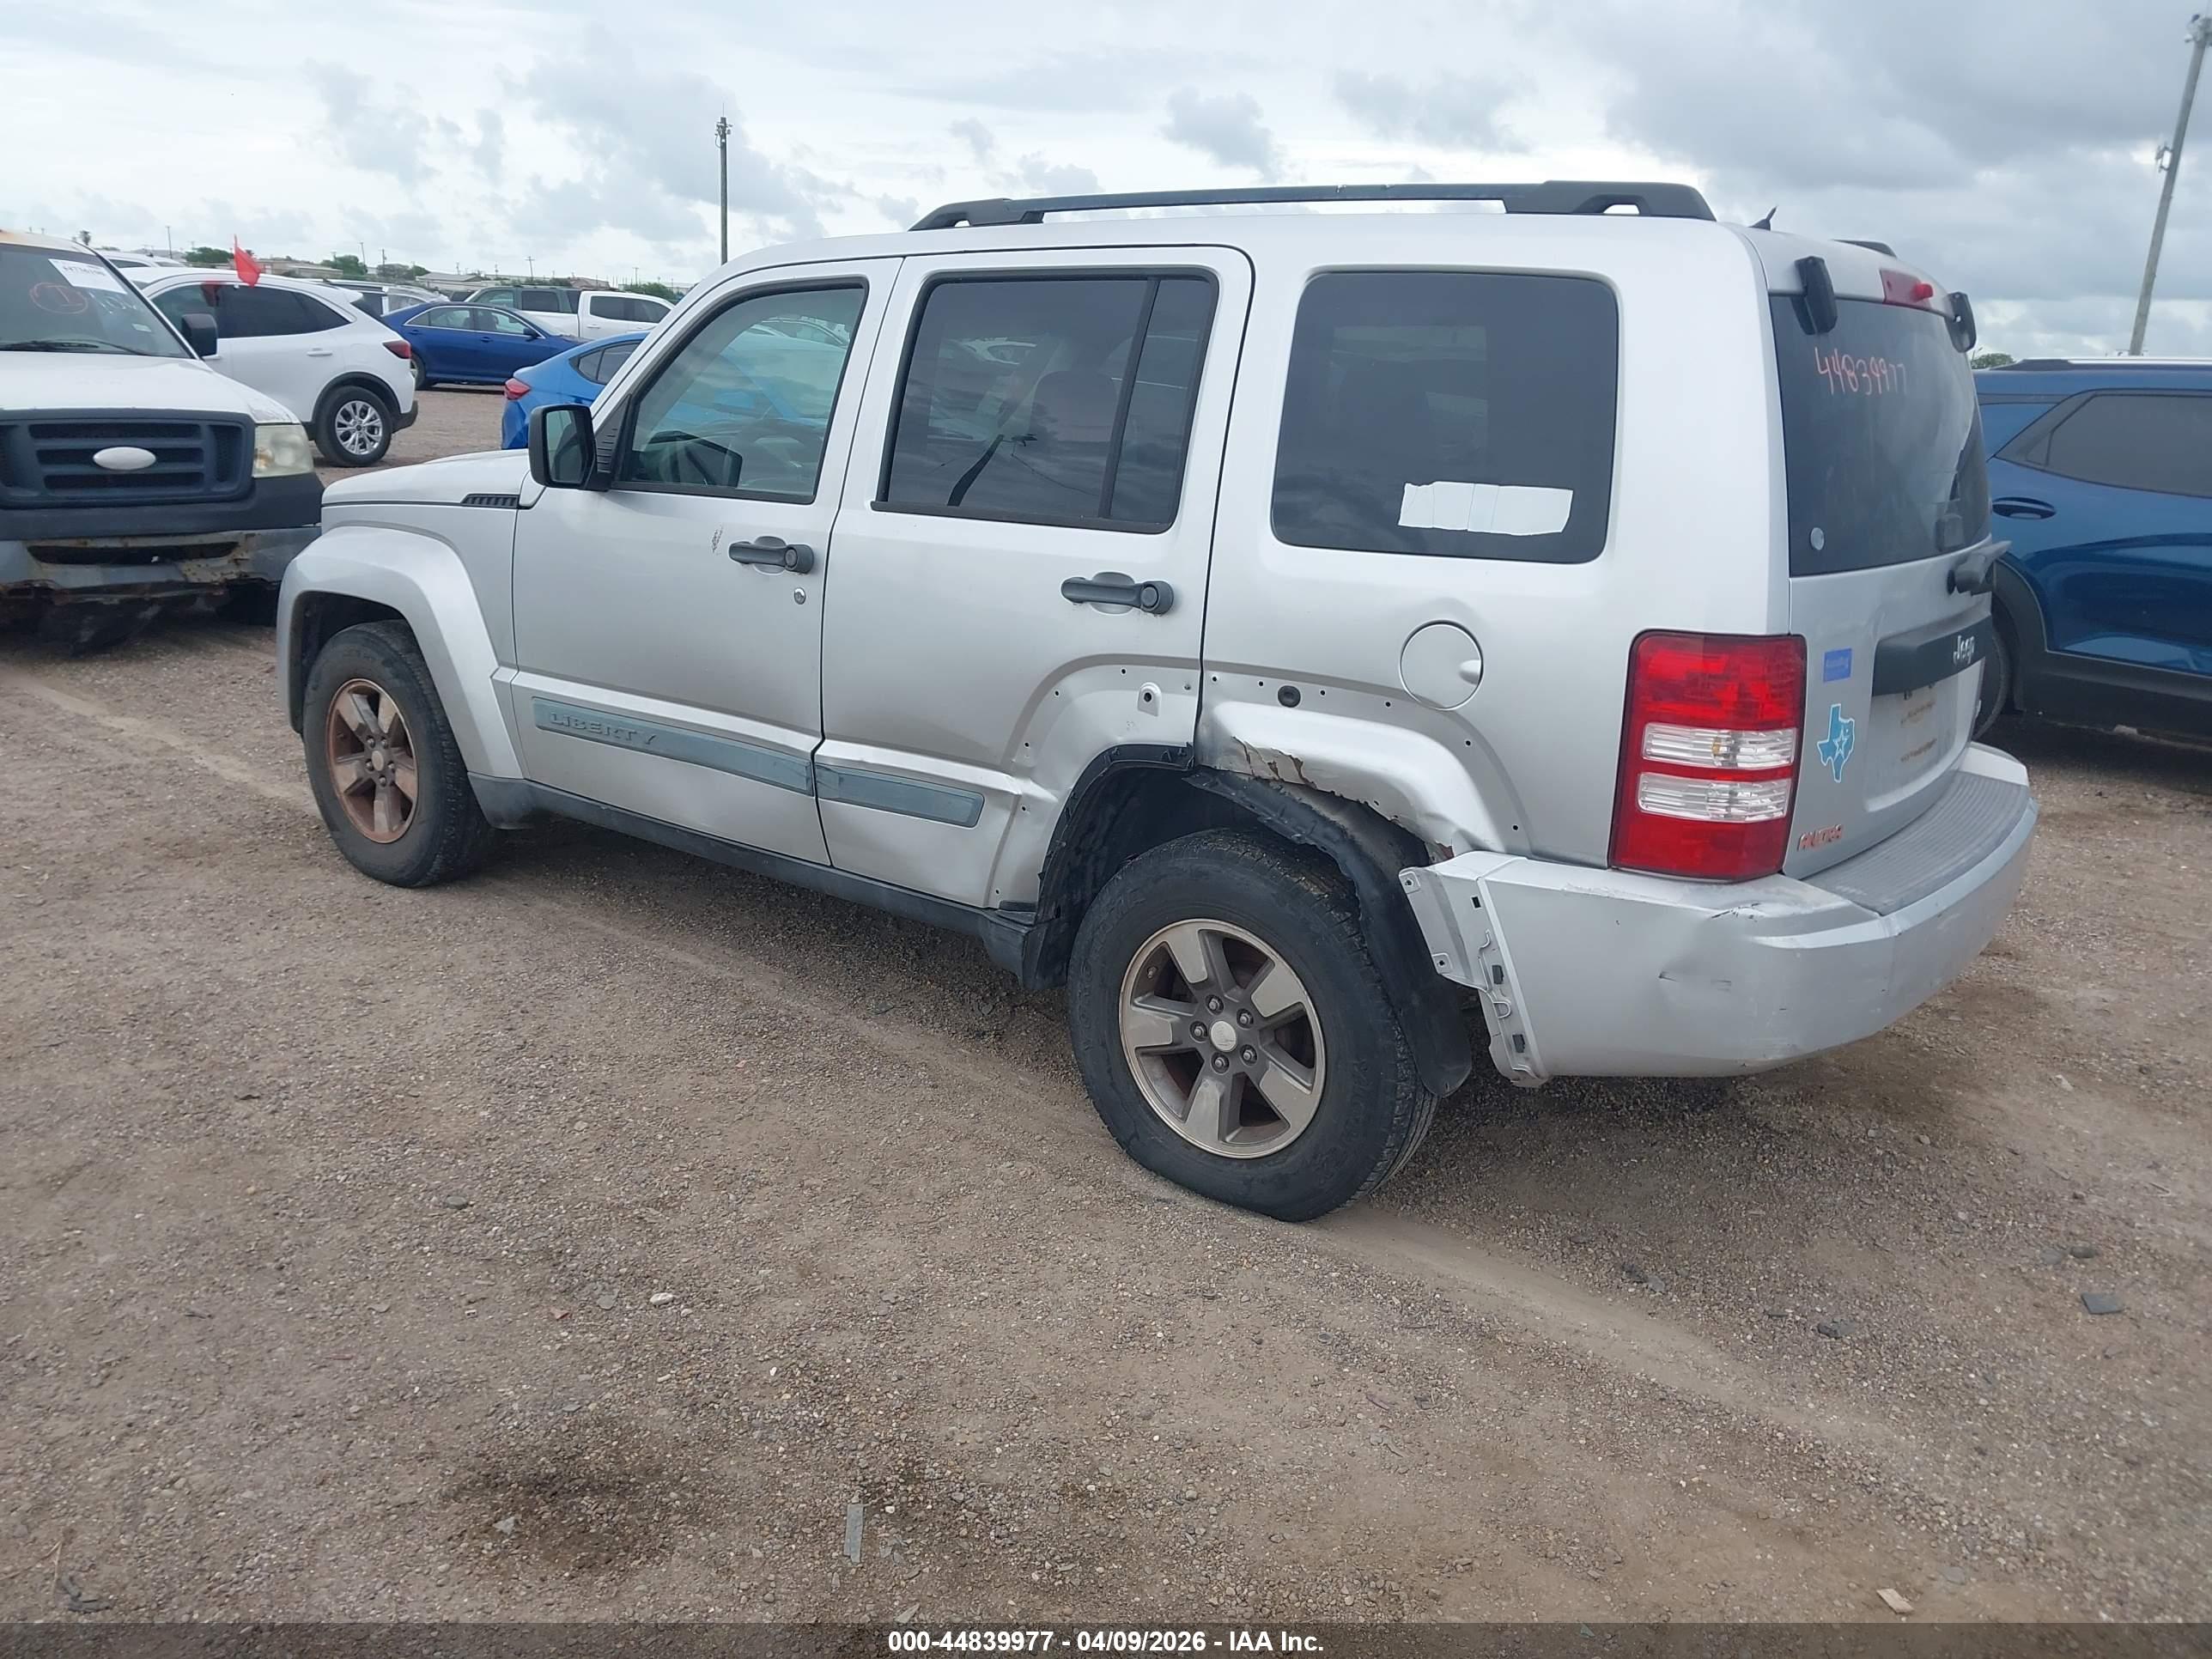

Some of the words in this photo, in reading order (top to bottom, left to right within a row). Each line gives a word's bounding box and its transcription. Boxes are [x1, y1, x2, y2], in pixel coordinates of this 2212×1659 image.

[1814, 346, 1907, 396] 44839977
[1953, 635, 1975, 665] Jeep
[549, 713, 657, 744] LIBERTY
